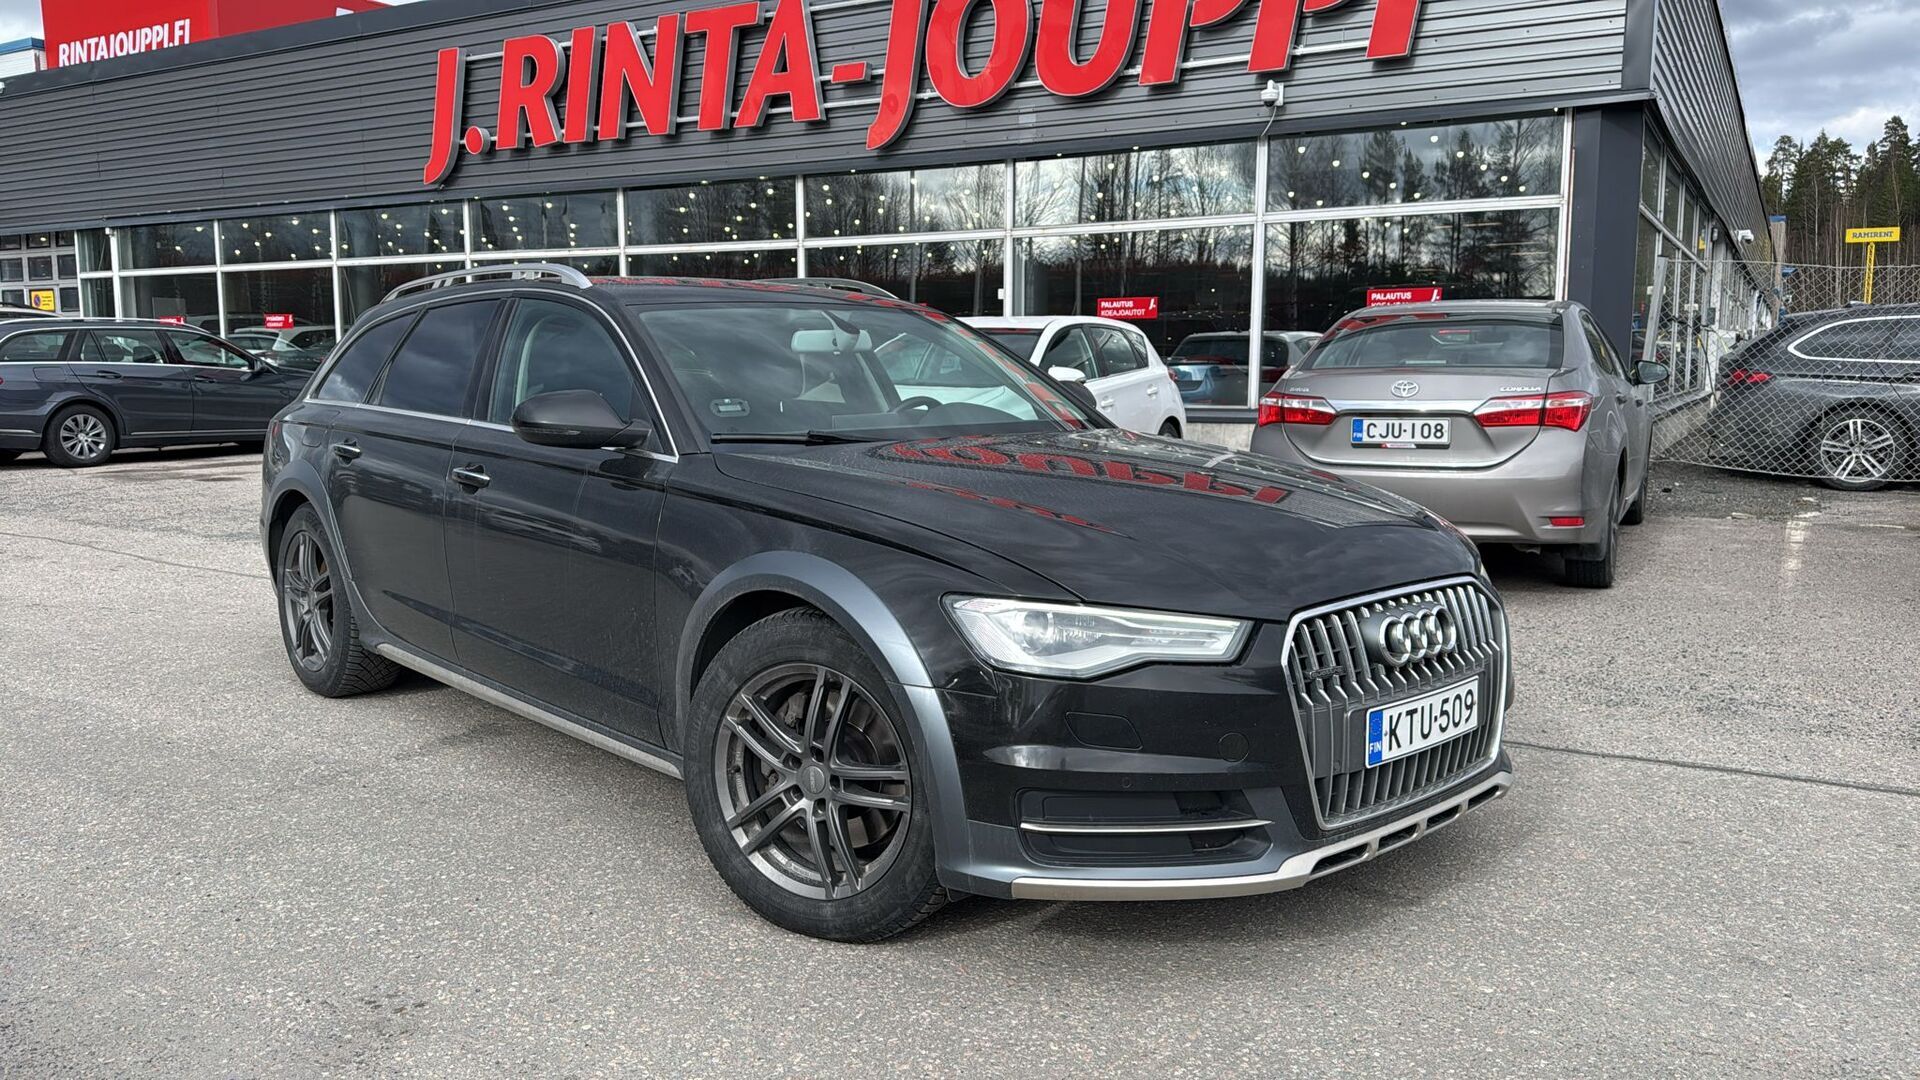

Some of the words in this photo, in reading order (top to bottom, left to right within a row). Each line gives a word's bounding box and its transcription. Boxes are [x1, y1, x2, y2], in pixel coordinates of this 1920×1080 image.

[1852, 230, 1894, 239] RAMIRENT
[1371, 291, 1412, 300] PALAUTUS
[1100, 300, 1134, 309] PALAUTUS
[1100, 308, 1146, 317] KOEAJOAUTOT
[1366, 422, 1445, 439] CJU-108
[1388, 688, 1474, 752] KTU-509
[1369, 741, 1382, 755] FIN
